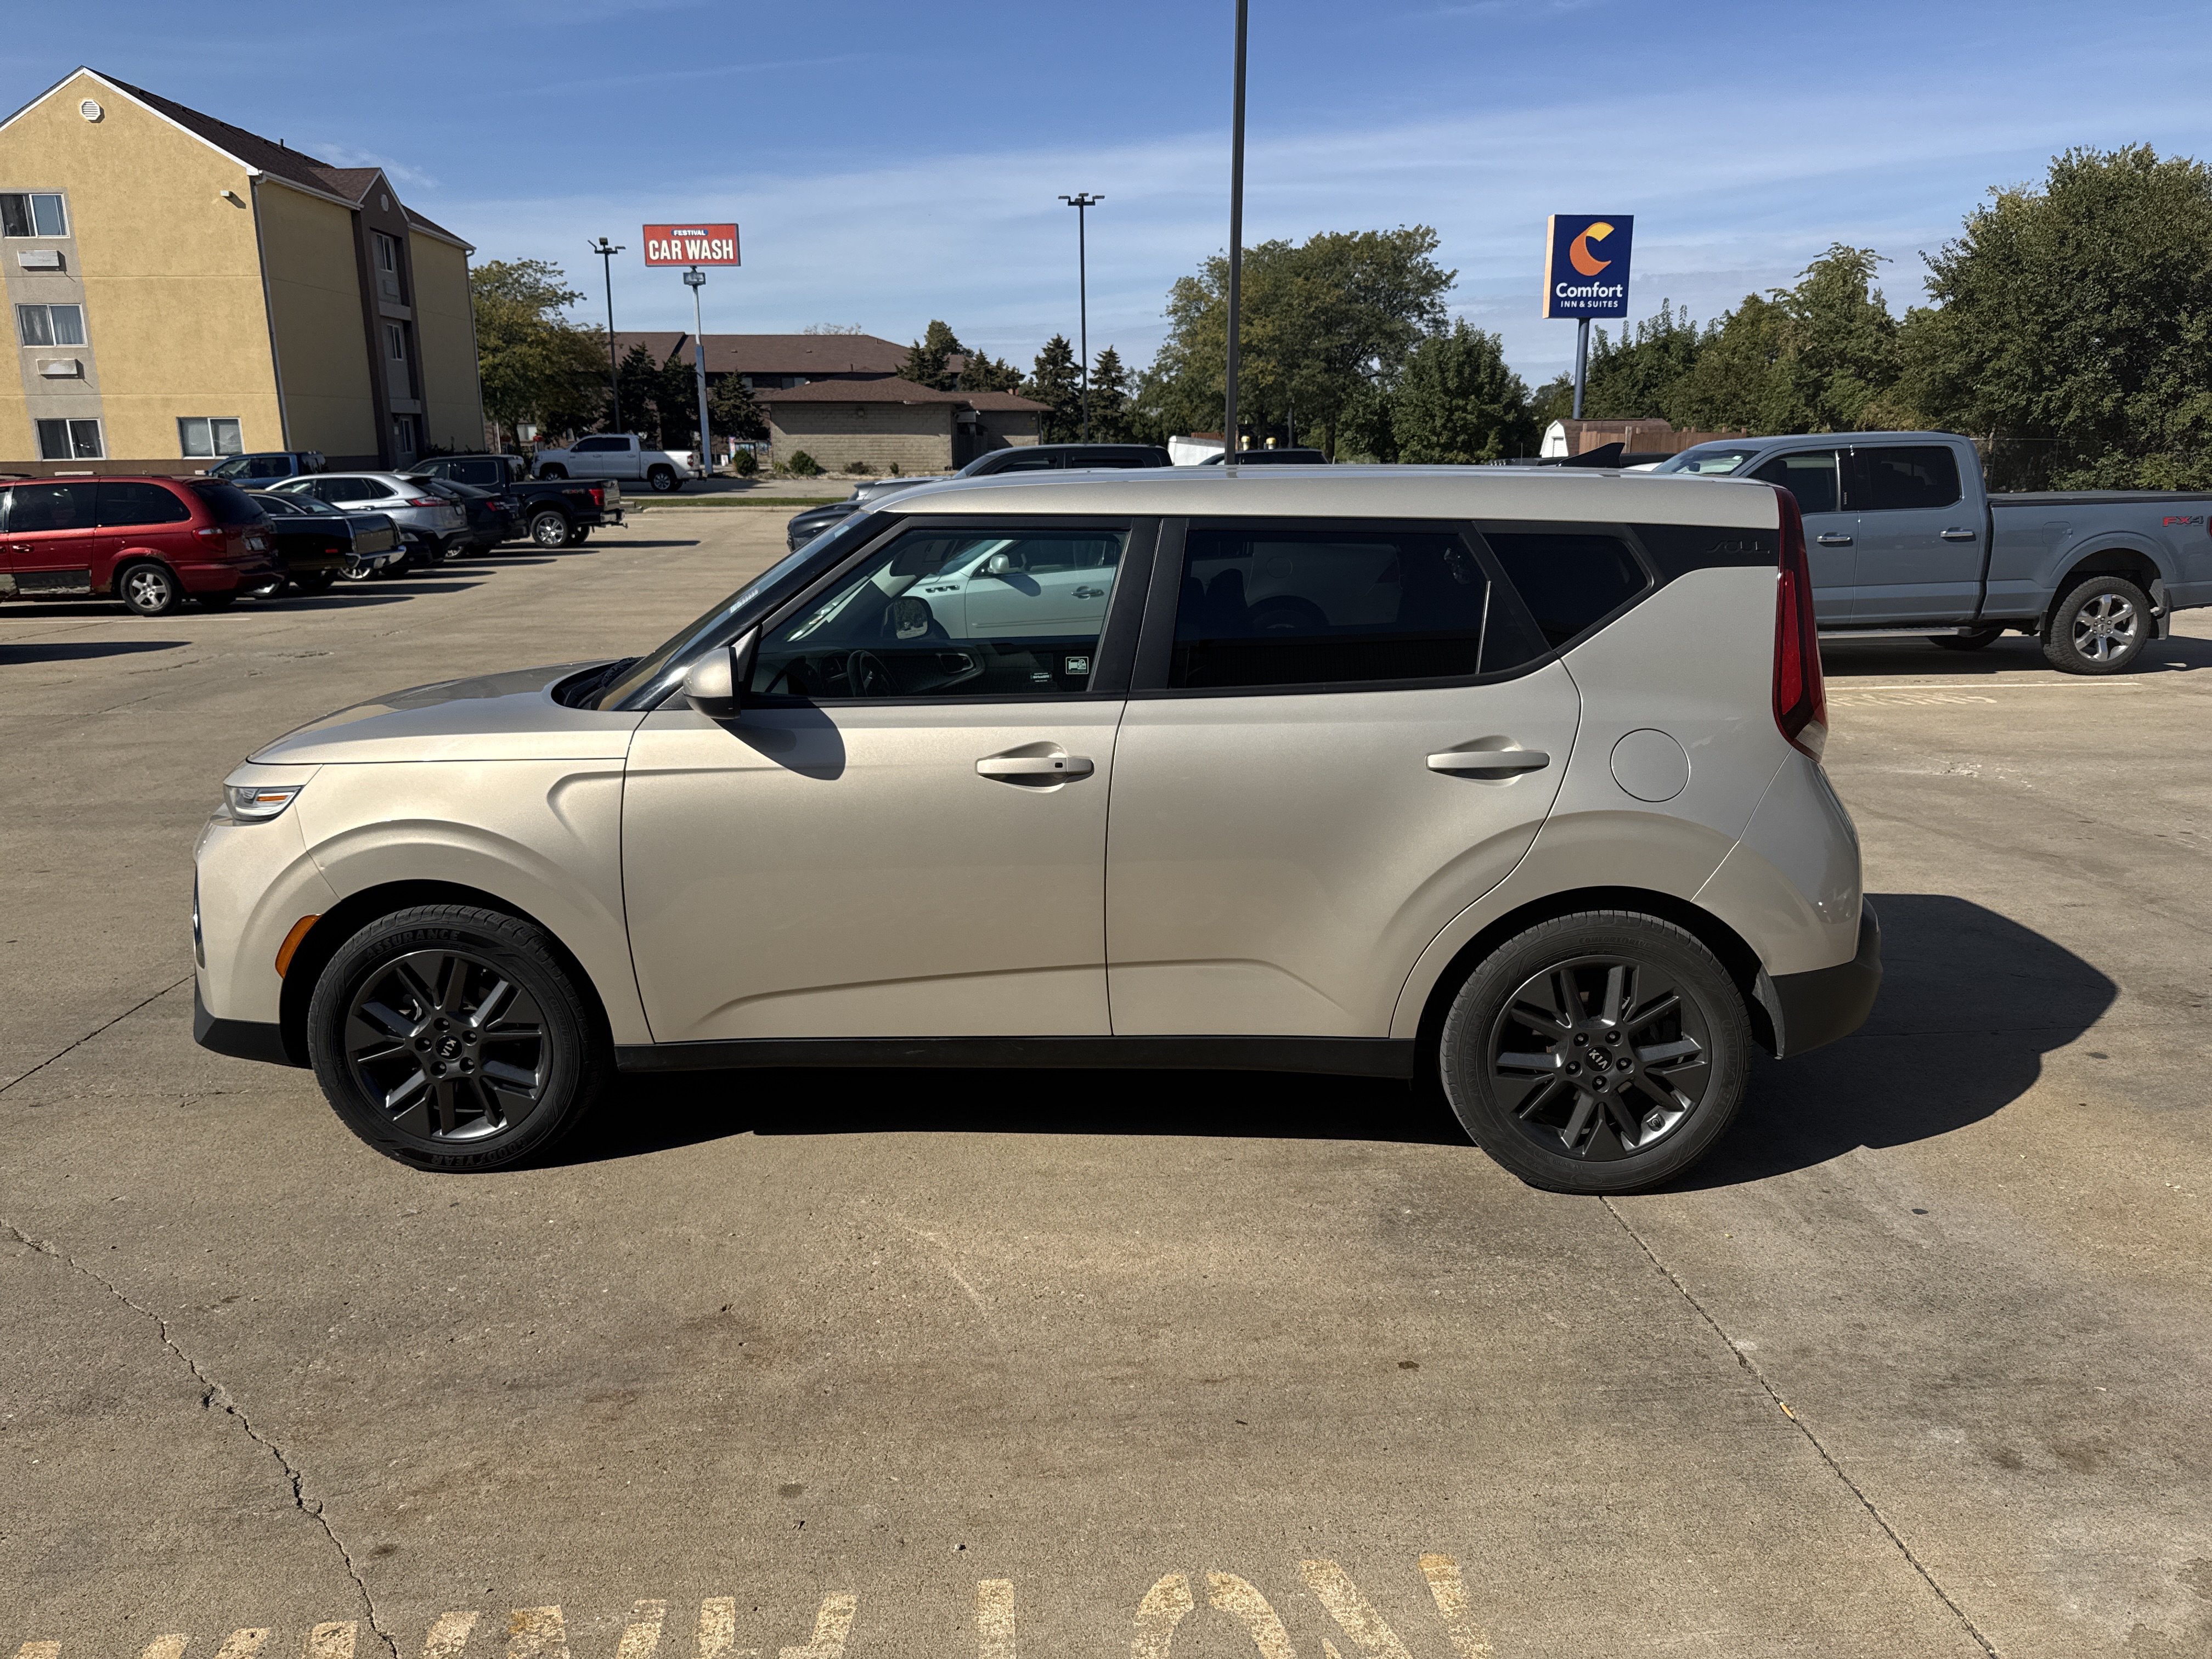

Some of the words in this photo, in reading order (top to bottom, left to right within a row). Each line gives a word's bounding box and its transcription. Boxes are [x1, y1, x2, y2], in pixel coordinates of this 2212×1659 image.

[648, 240, 682, 261] CAR
[685, 239, 734, 260] WASH
[1556, 281, 1623, 297] Comfort
[2163, 516, 2204, 527] FX4
[1705, 540, 1770, 554] SOUL
[365, 928, 460, 959] ASSURANCE
[441, 1037, 456, 1056] KIA
[1589, 1049, 1608, 1069] KIA
[431, 1137, 527, 1166] GOODYEAR
